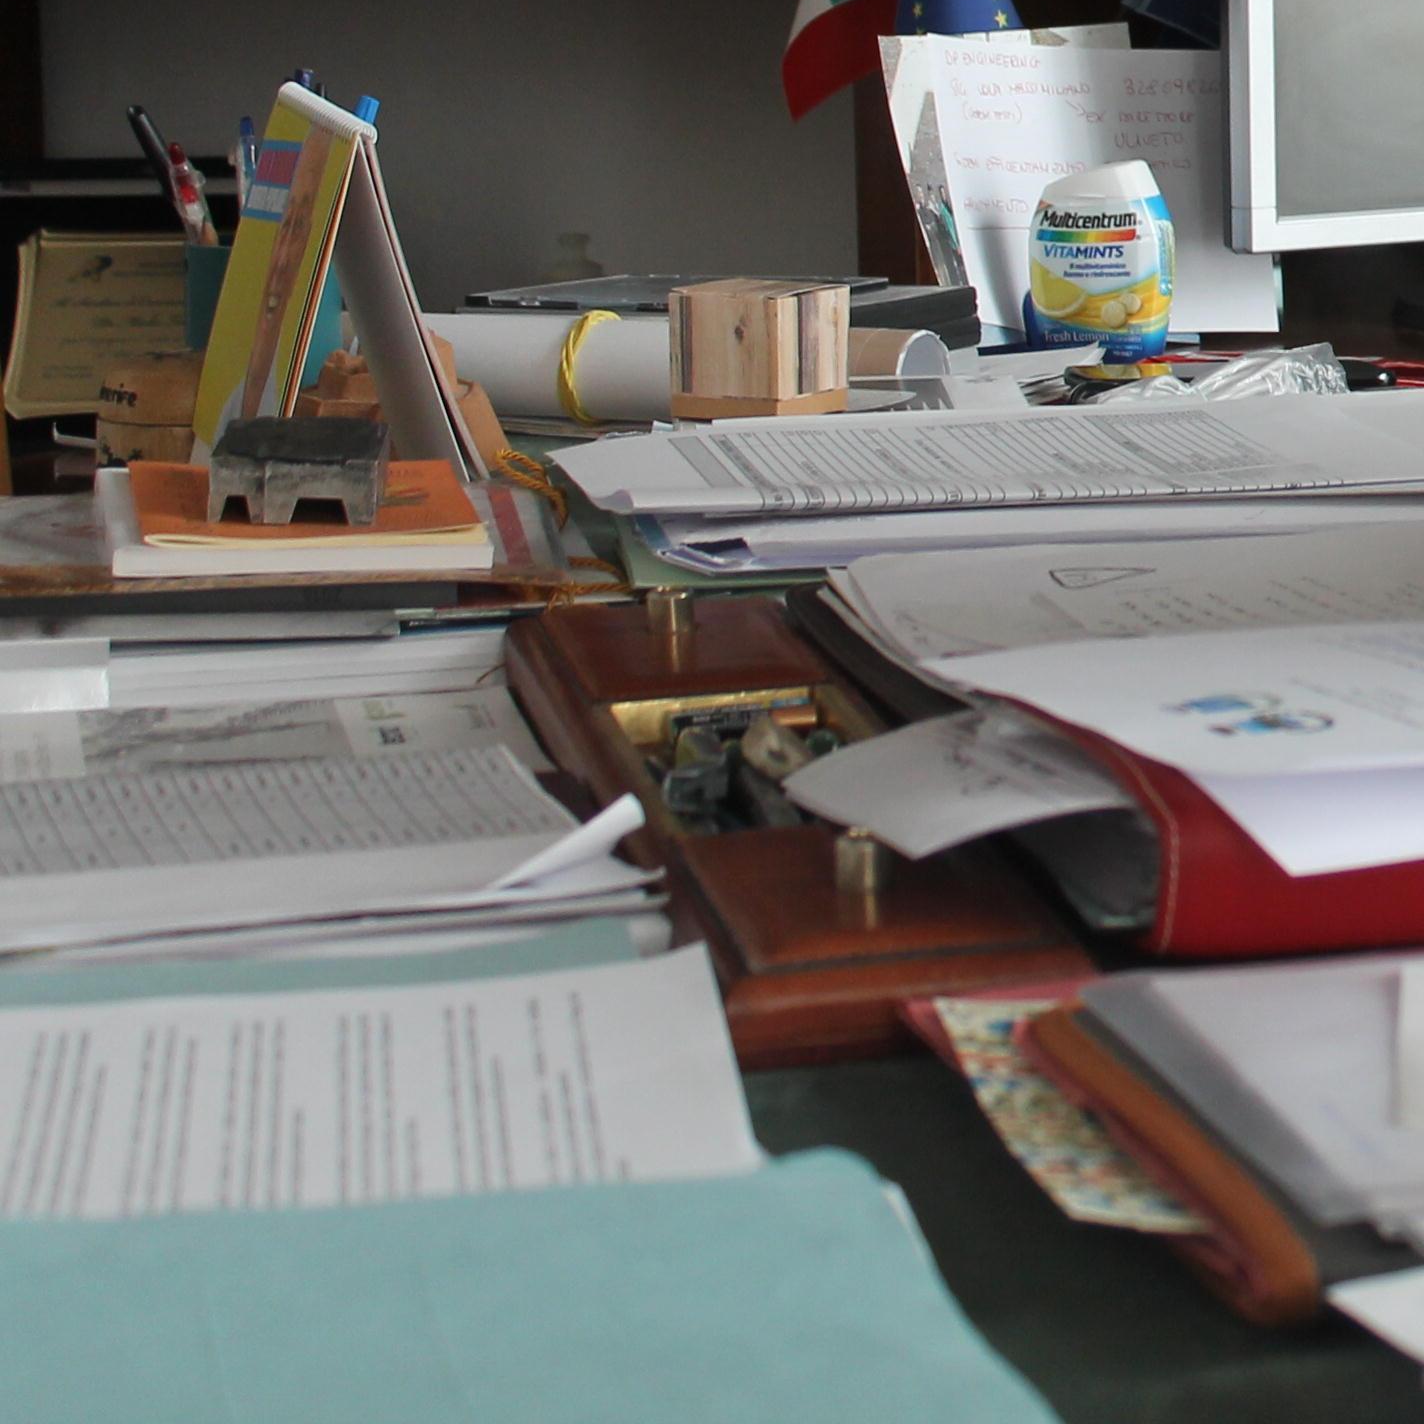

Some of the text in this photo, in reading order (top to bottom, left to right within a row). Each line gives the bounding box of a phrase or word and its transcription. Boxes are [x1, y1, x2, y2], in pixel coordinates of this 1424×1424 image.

[1040, 209, 1137, 229] Multicentrum
[1044, 329, 1110, 343] Fresh Lemon
